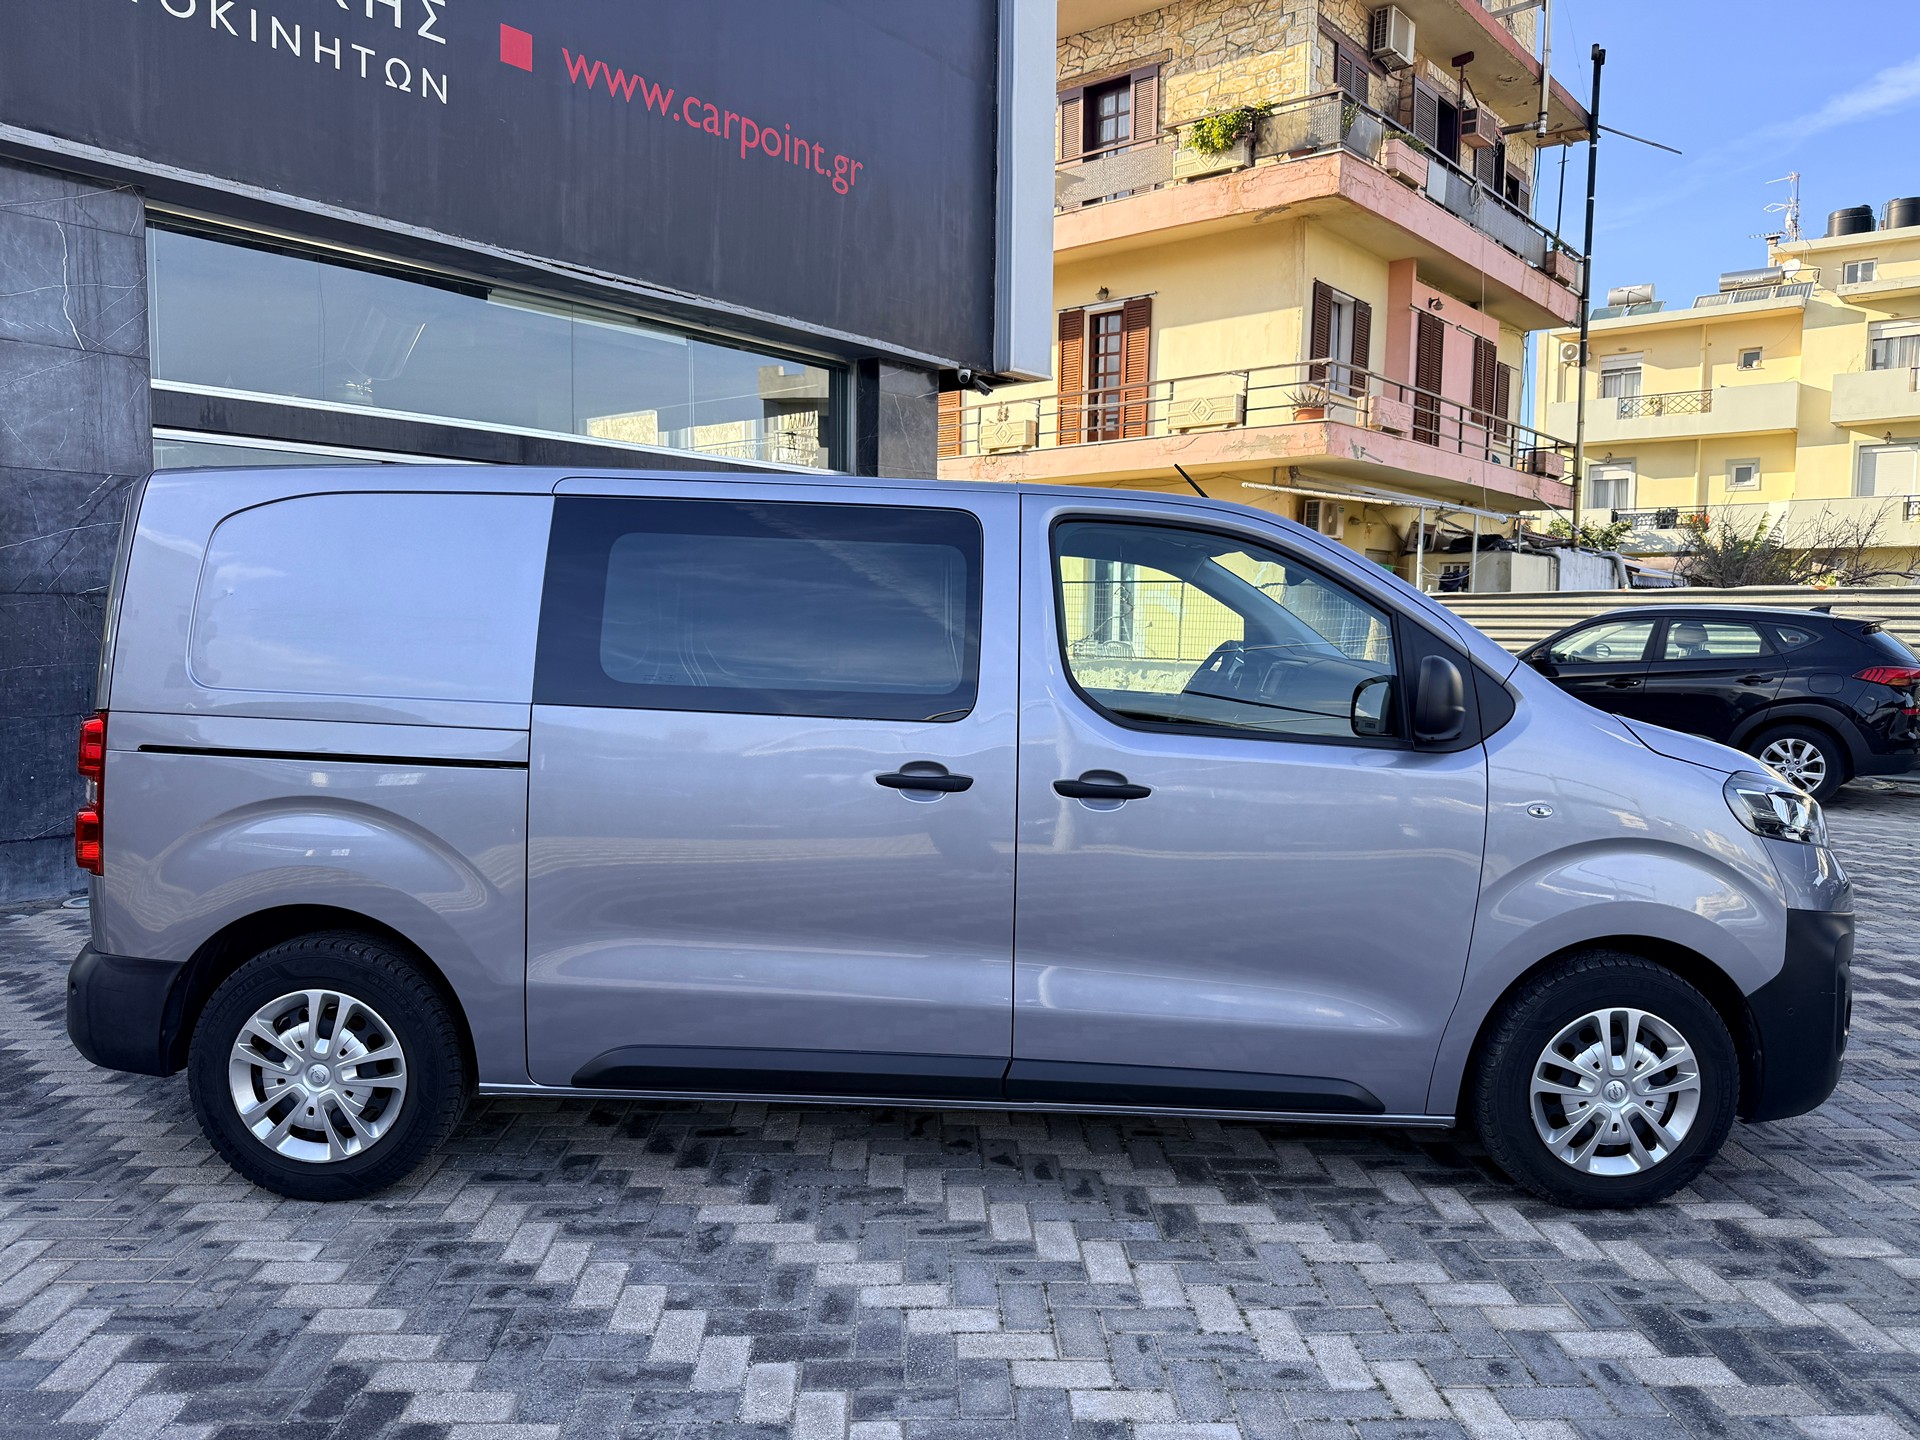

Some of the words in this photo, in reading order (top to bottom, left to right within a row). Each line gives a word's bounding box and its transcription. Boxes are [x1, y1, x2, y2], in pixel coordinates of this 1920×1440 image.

[131, 0, 447, 104] ΟΚΙΝΗΤΩΝ
[336, 0, 447, 45] ΗΣ
[561, 47, 863, 195] www.carpoint.gr
